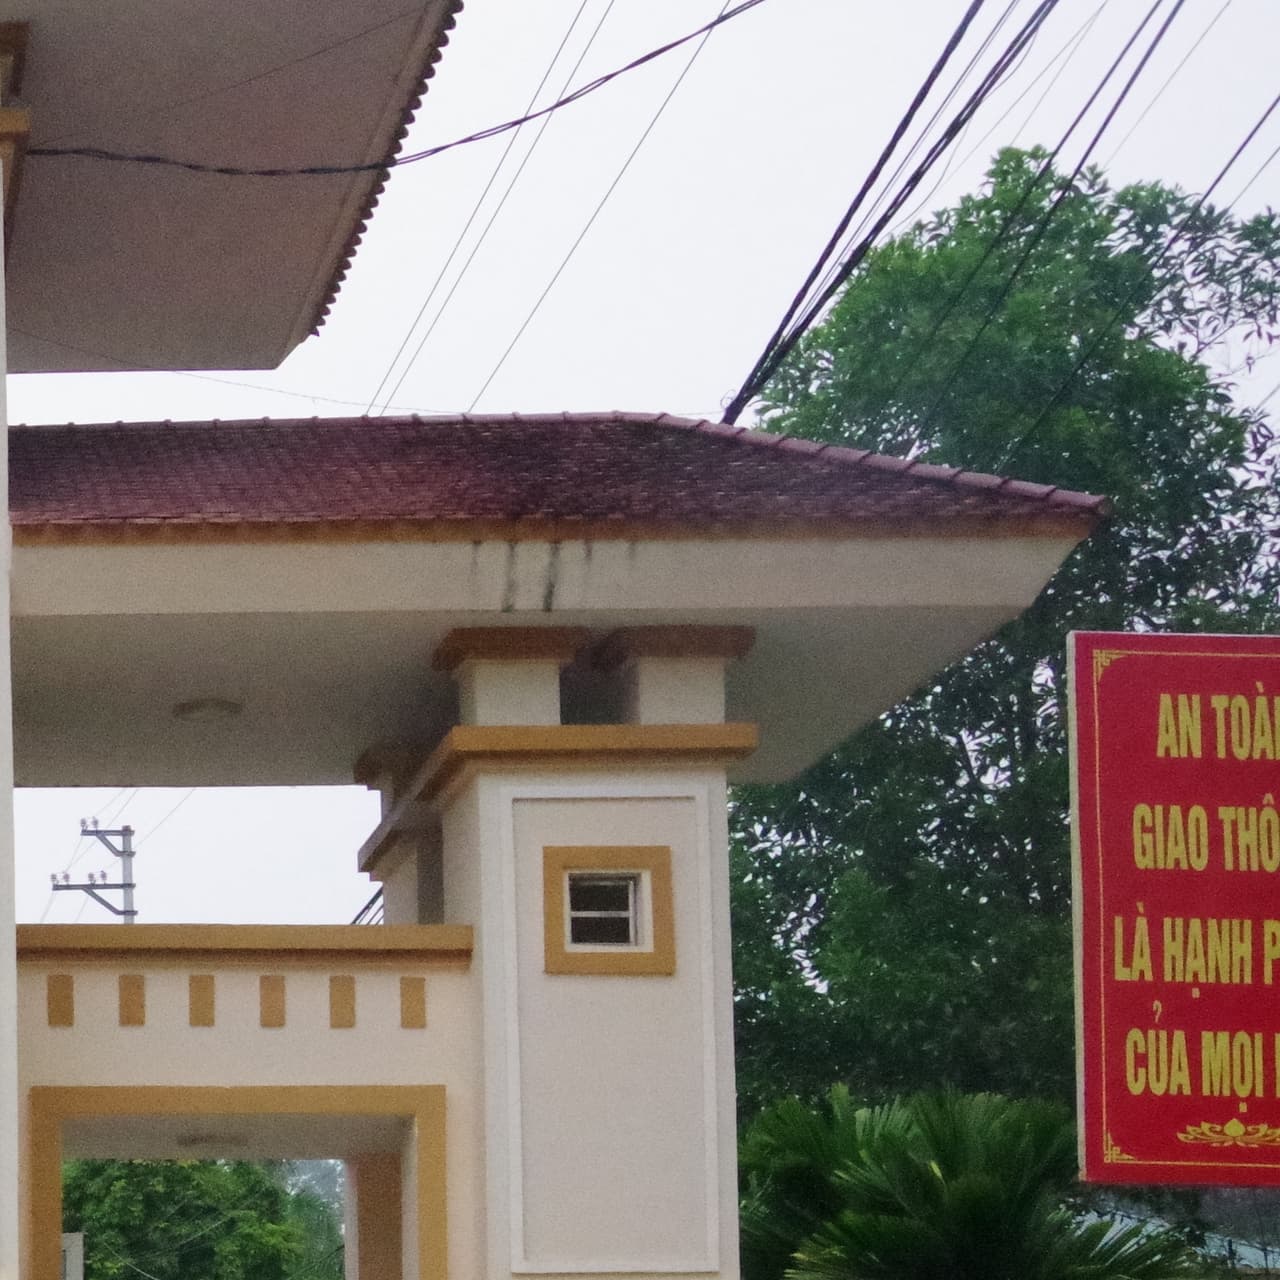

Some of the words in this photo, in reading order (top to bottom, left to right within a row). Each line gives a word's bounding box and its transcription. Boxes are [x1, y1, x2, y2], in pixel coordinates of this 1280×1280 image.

[1157, 694, 1201, 757] AN
[1211, 682, 1280, 760] TOÀ
[1133, 804, 1208, 870] GIAO
[1115, 903, 1153, 981] LÀ
[1164, 917, 1252, 997] HẠNH
[1126, 1001, 1191, 1095] CỦA
[1202, 1031, 1263, 1112] MỌI
